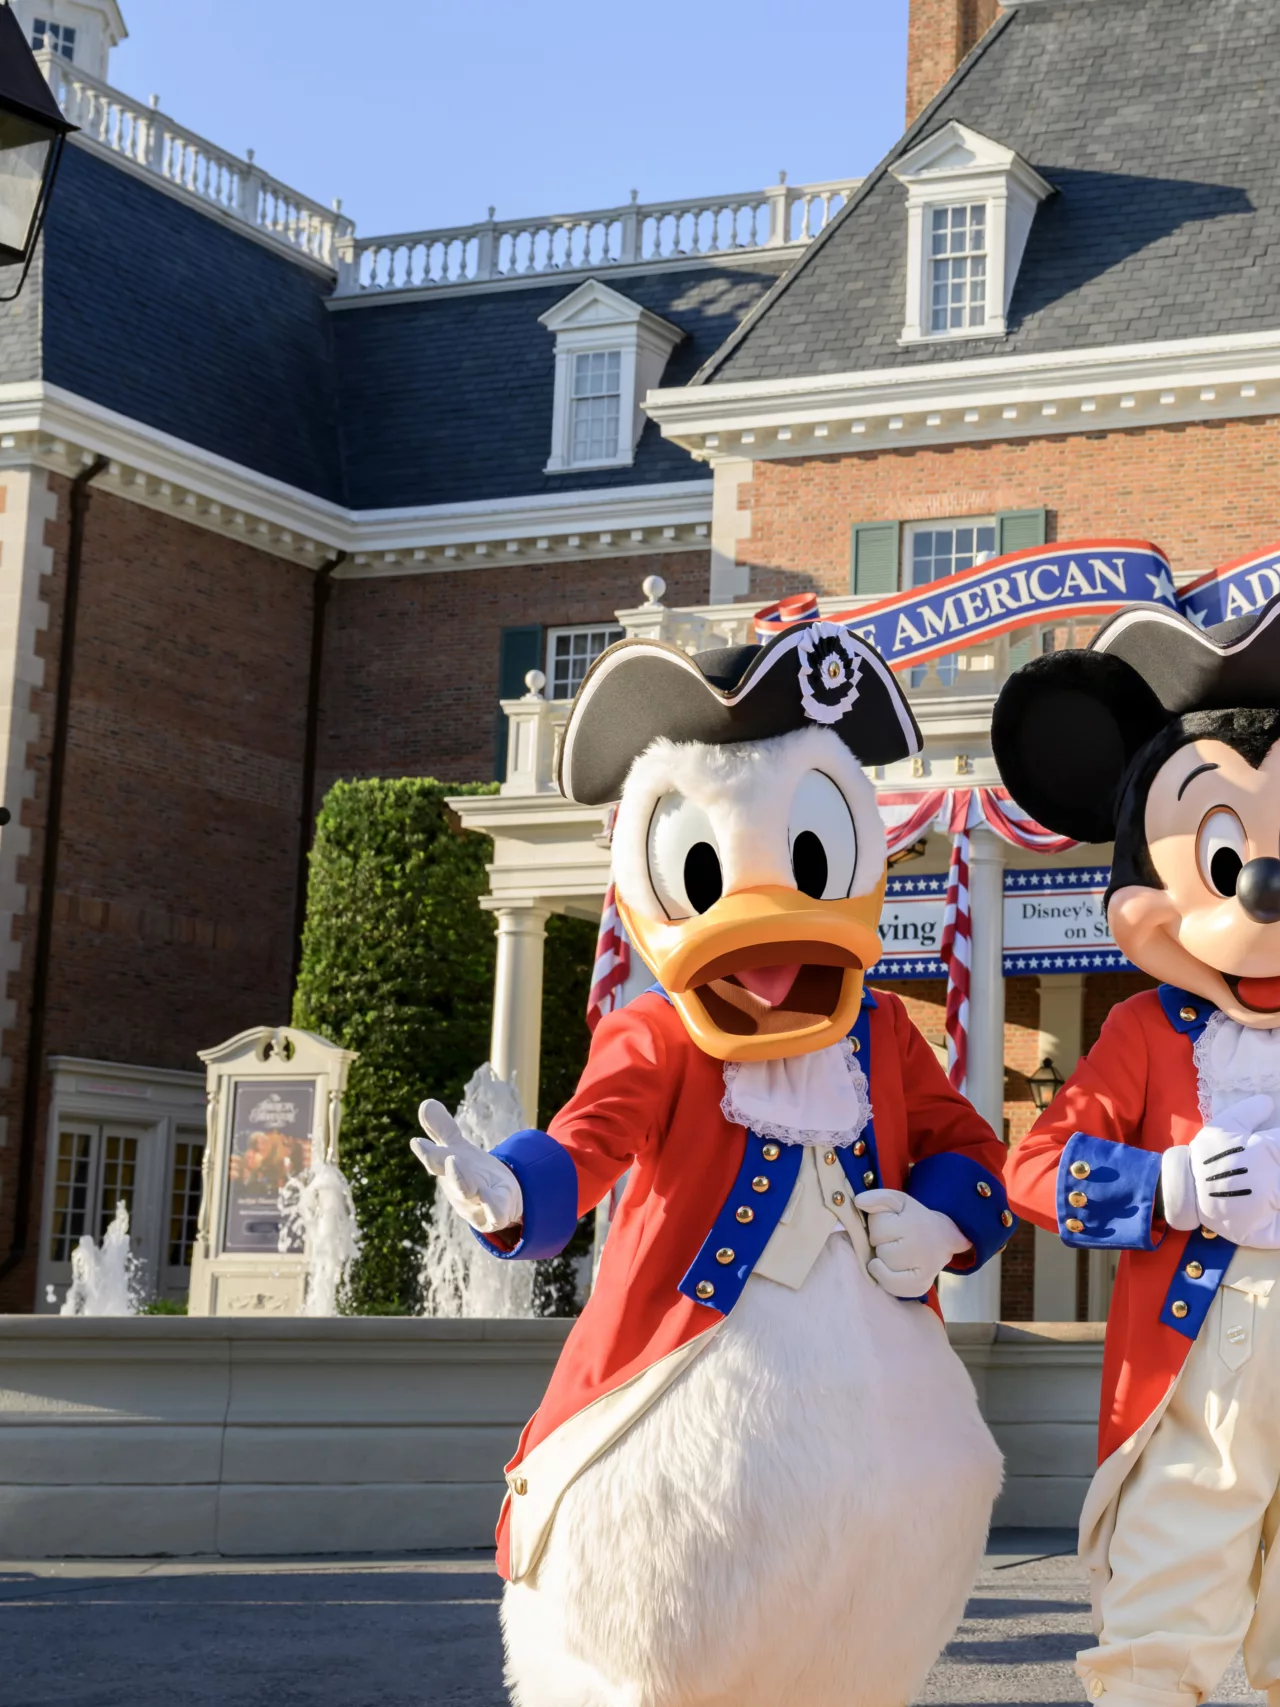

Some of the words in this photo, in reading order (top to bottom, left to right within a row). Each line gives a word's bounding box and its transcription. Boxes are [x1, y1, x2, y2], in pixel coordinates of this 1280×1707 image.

[892, 558, 1127, 652] AMERICAN
[1022, 902, 1093, 921] Disney's
[1064, 927, 1087, 939] on
